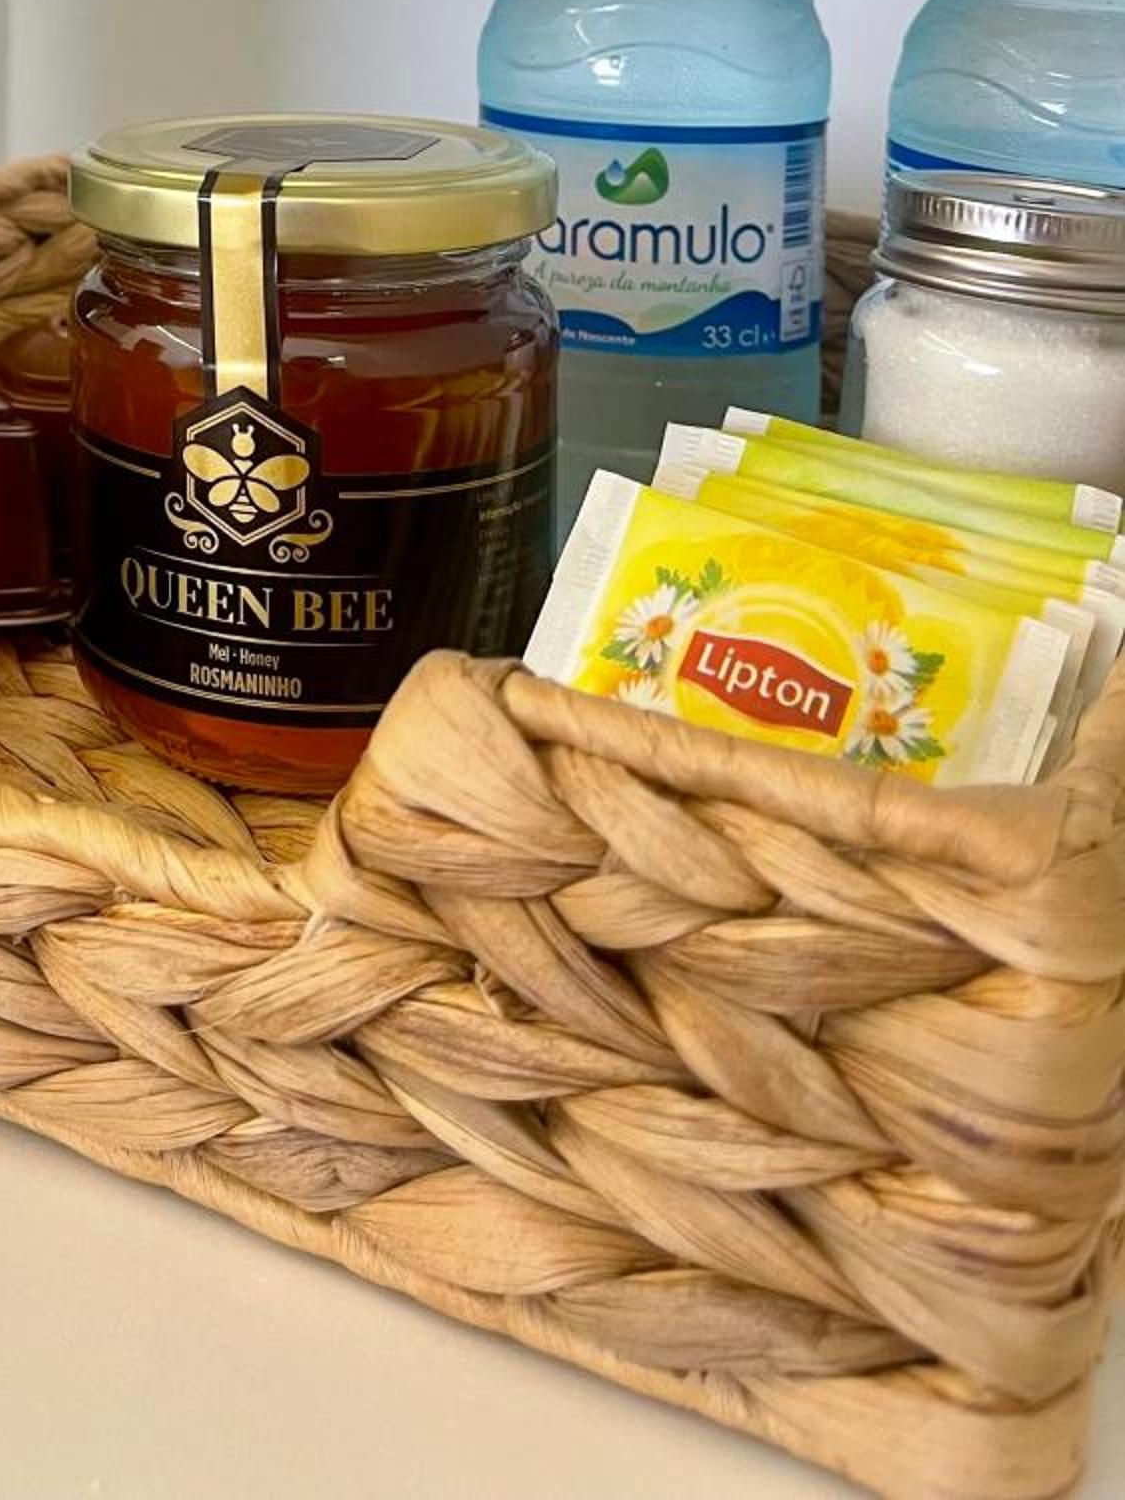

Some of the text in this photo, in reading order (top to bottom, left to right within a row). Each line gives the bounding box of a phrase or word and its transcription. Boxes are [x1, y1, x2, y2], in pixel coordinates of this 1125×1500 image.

[535, 203, 766, 265] aramulo
[701, 324, 732, 348] 33
[120, 556, 394, 631] QUEEN BEE
[189, 662, 303, 699] ROSMANINHO
[208, 642, 280, 671] Mel Honey
[696, 641, 831, 721] Lipton
